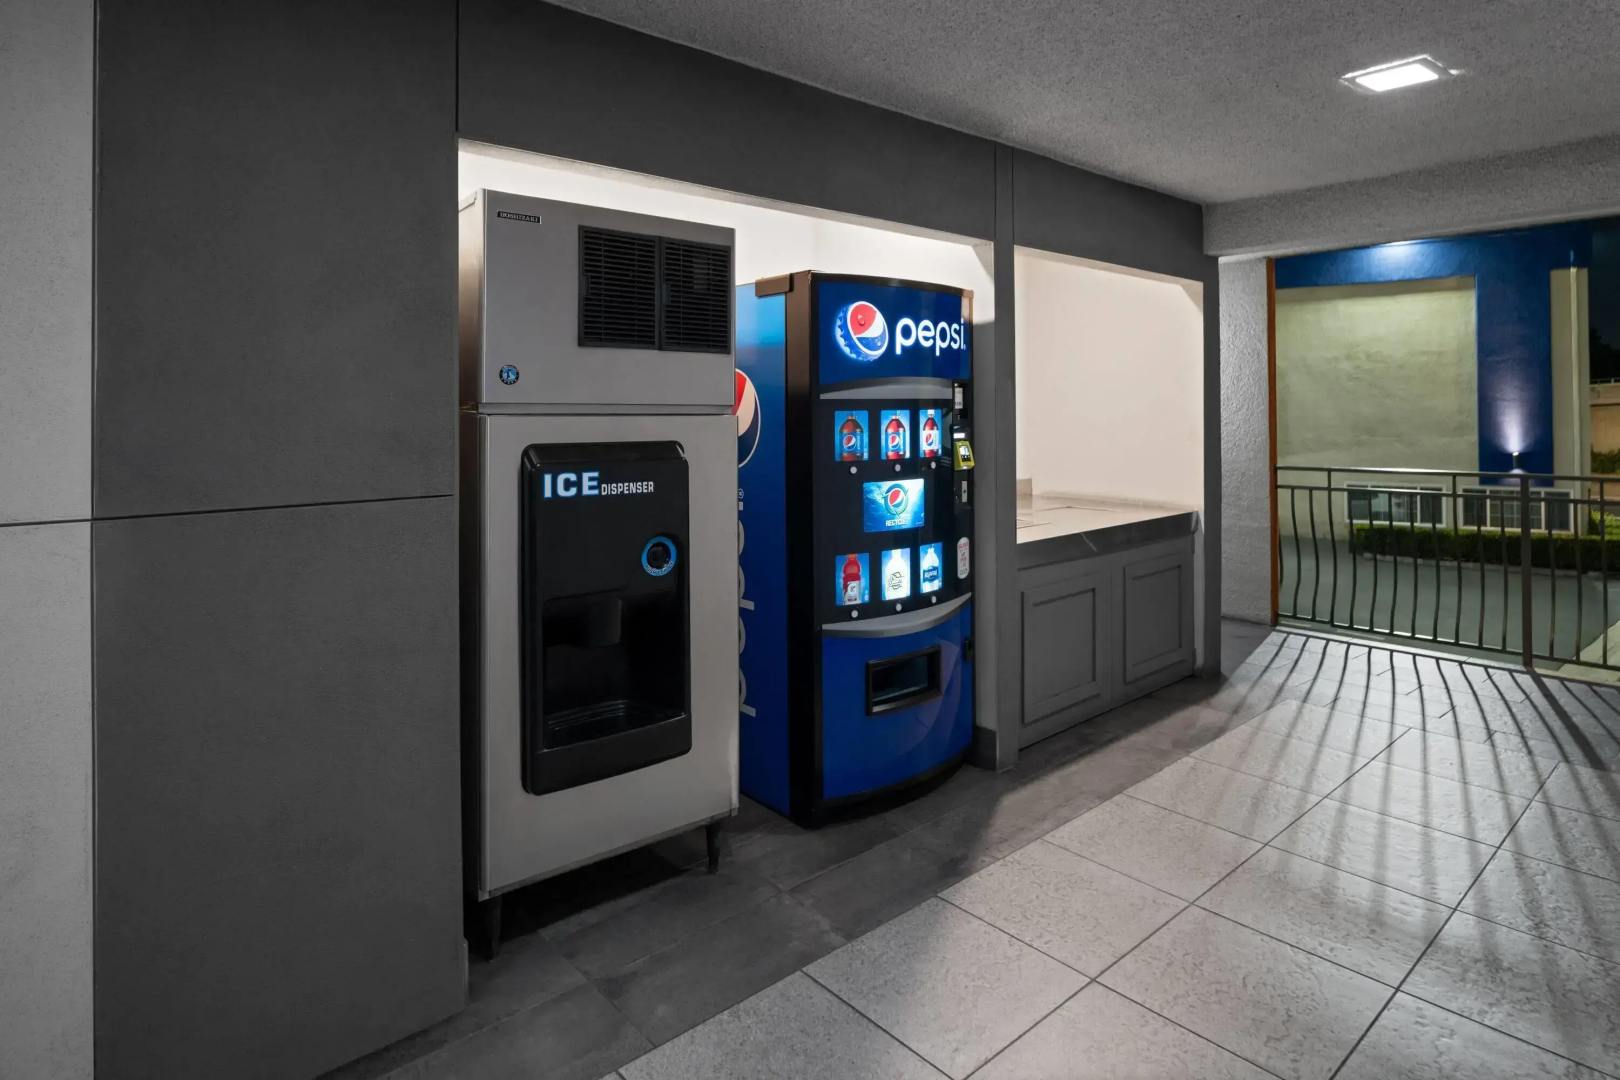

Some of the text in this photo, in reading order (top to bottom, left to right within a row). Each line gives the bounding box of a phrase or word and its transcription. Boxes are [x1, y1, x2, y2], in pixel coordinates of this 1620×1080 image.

[500, 211, 539, 223] HOSHIZAKI
[895, 317, 965, 357] pepsi
[543, 471, 654, 498] ICE DISPENSER
